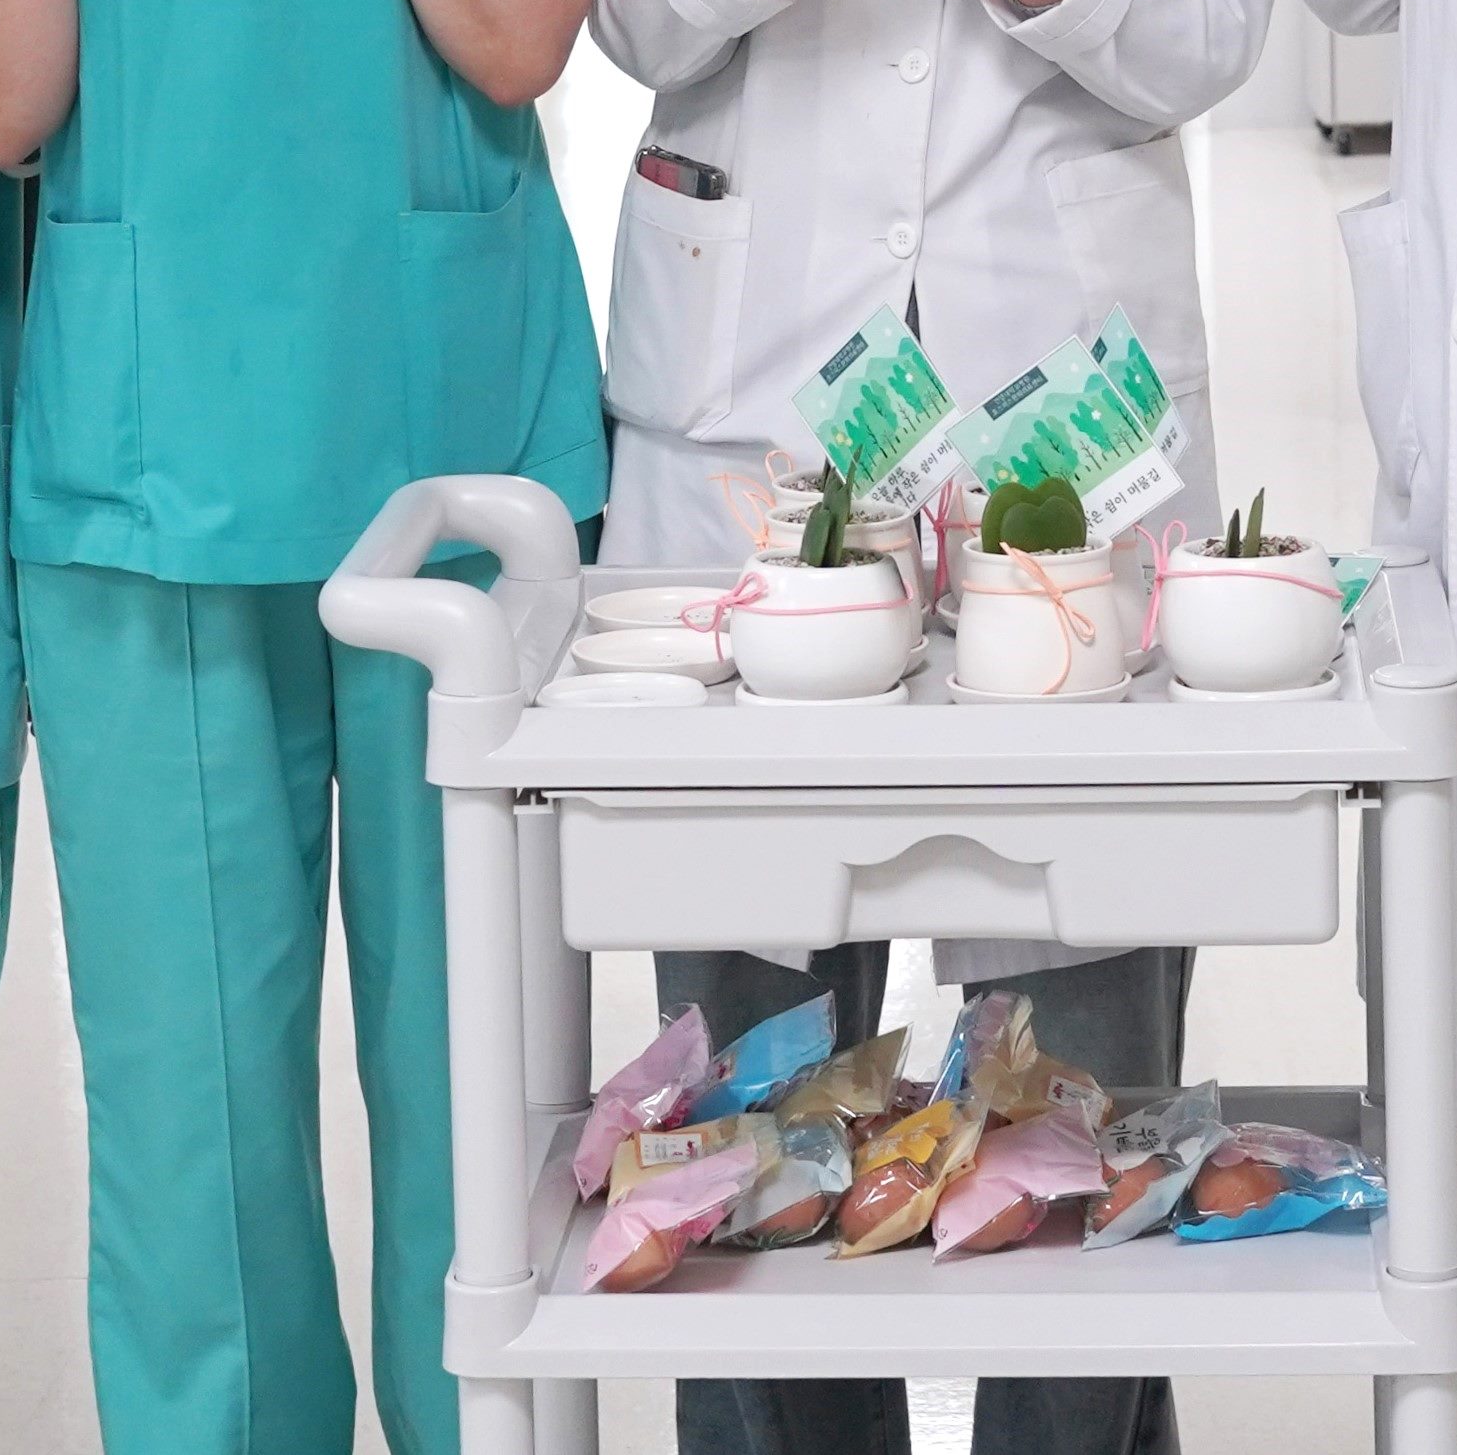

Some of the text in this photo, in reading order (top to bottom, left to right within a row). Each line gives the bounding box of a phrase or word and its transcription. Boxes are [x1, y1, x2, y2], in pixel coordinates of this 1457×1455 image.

[920, 452, 939, 475] 쉼이
[871, 485, 889, 502] 오늘
[1105, 491, 1128, 514] 쉼이
[1127, 467, 1161, 495] 머물길
